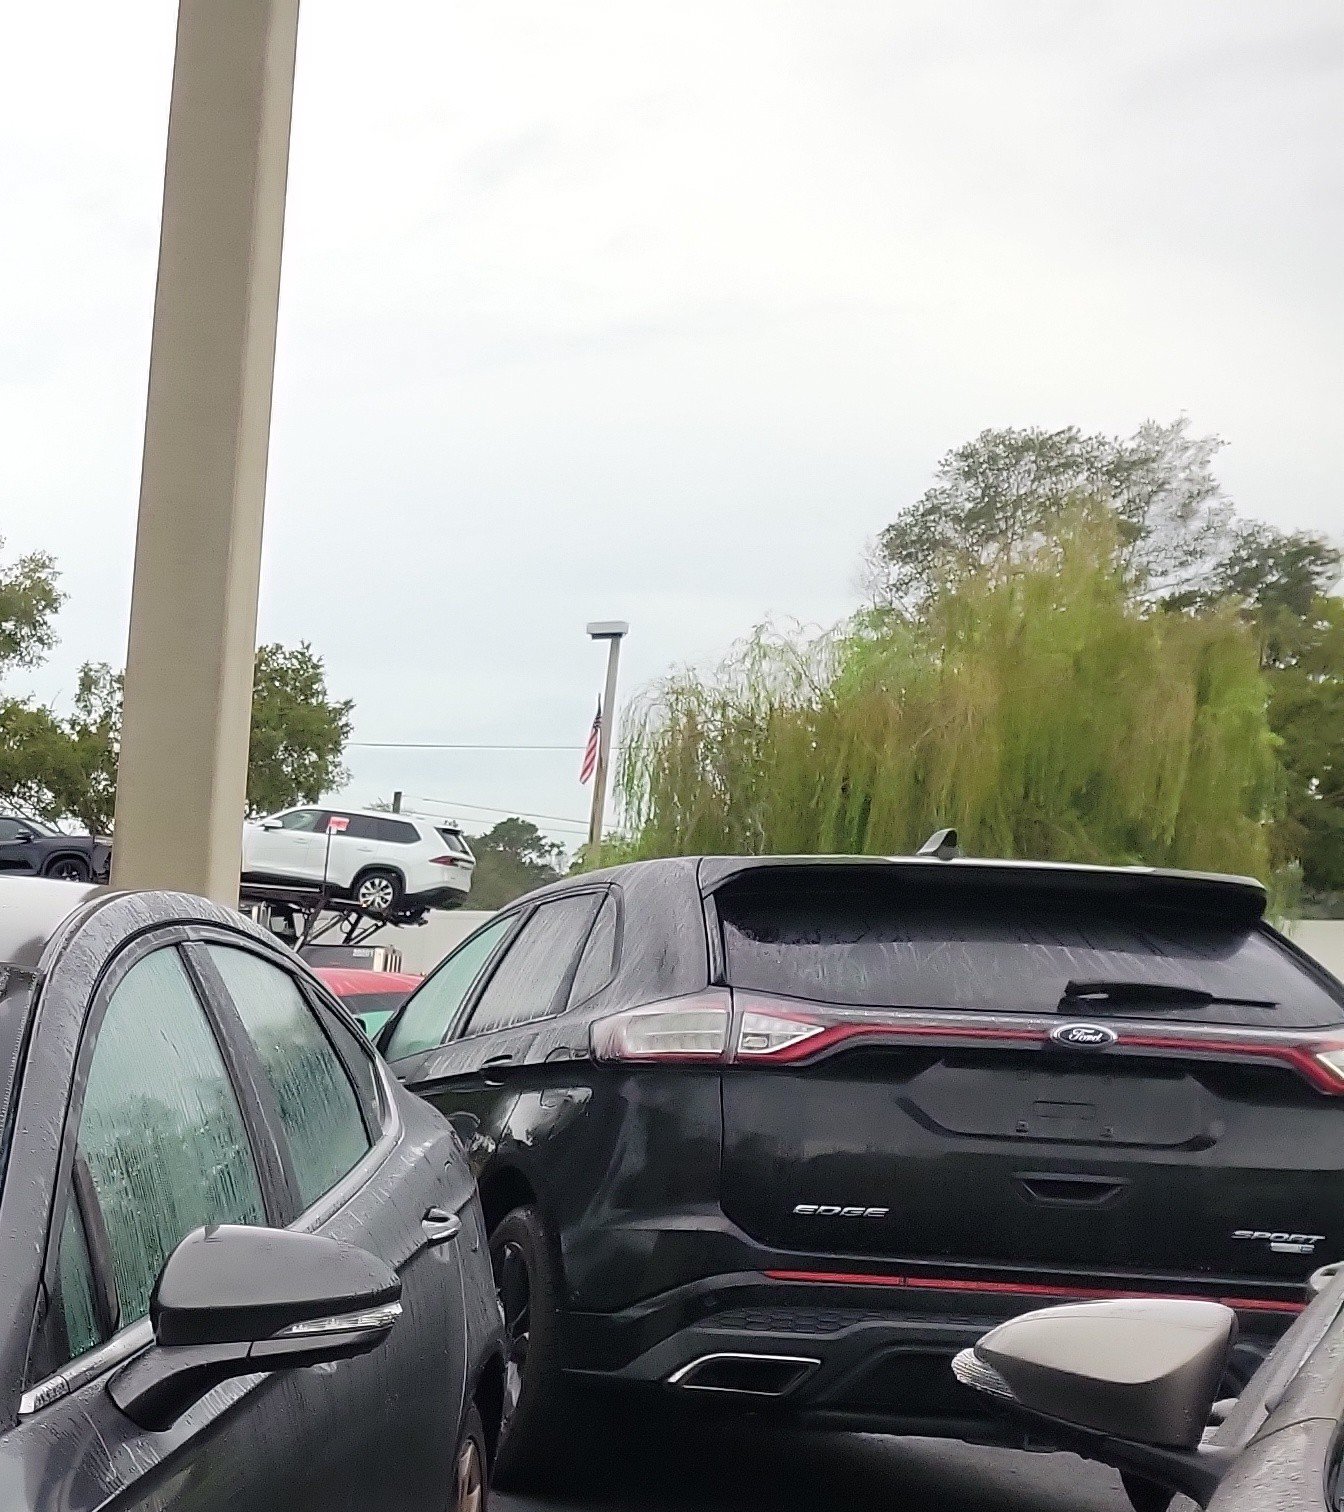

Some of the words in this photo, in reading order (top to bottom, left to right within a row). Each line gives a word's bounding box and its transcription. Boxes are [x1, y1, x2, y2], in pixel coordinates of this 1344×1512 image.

[1068, 1028, 1104, 1043] Ford
[793, 1204, 890, 1218] EDGE
[1231, 1230, 1326, 1244] SPORT
